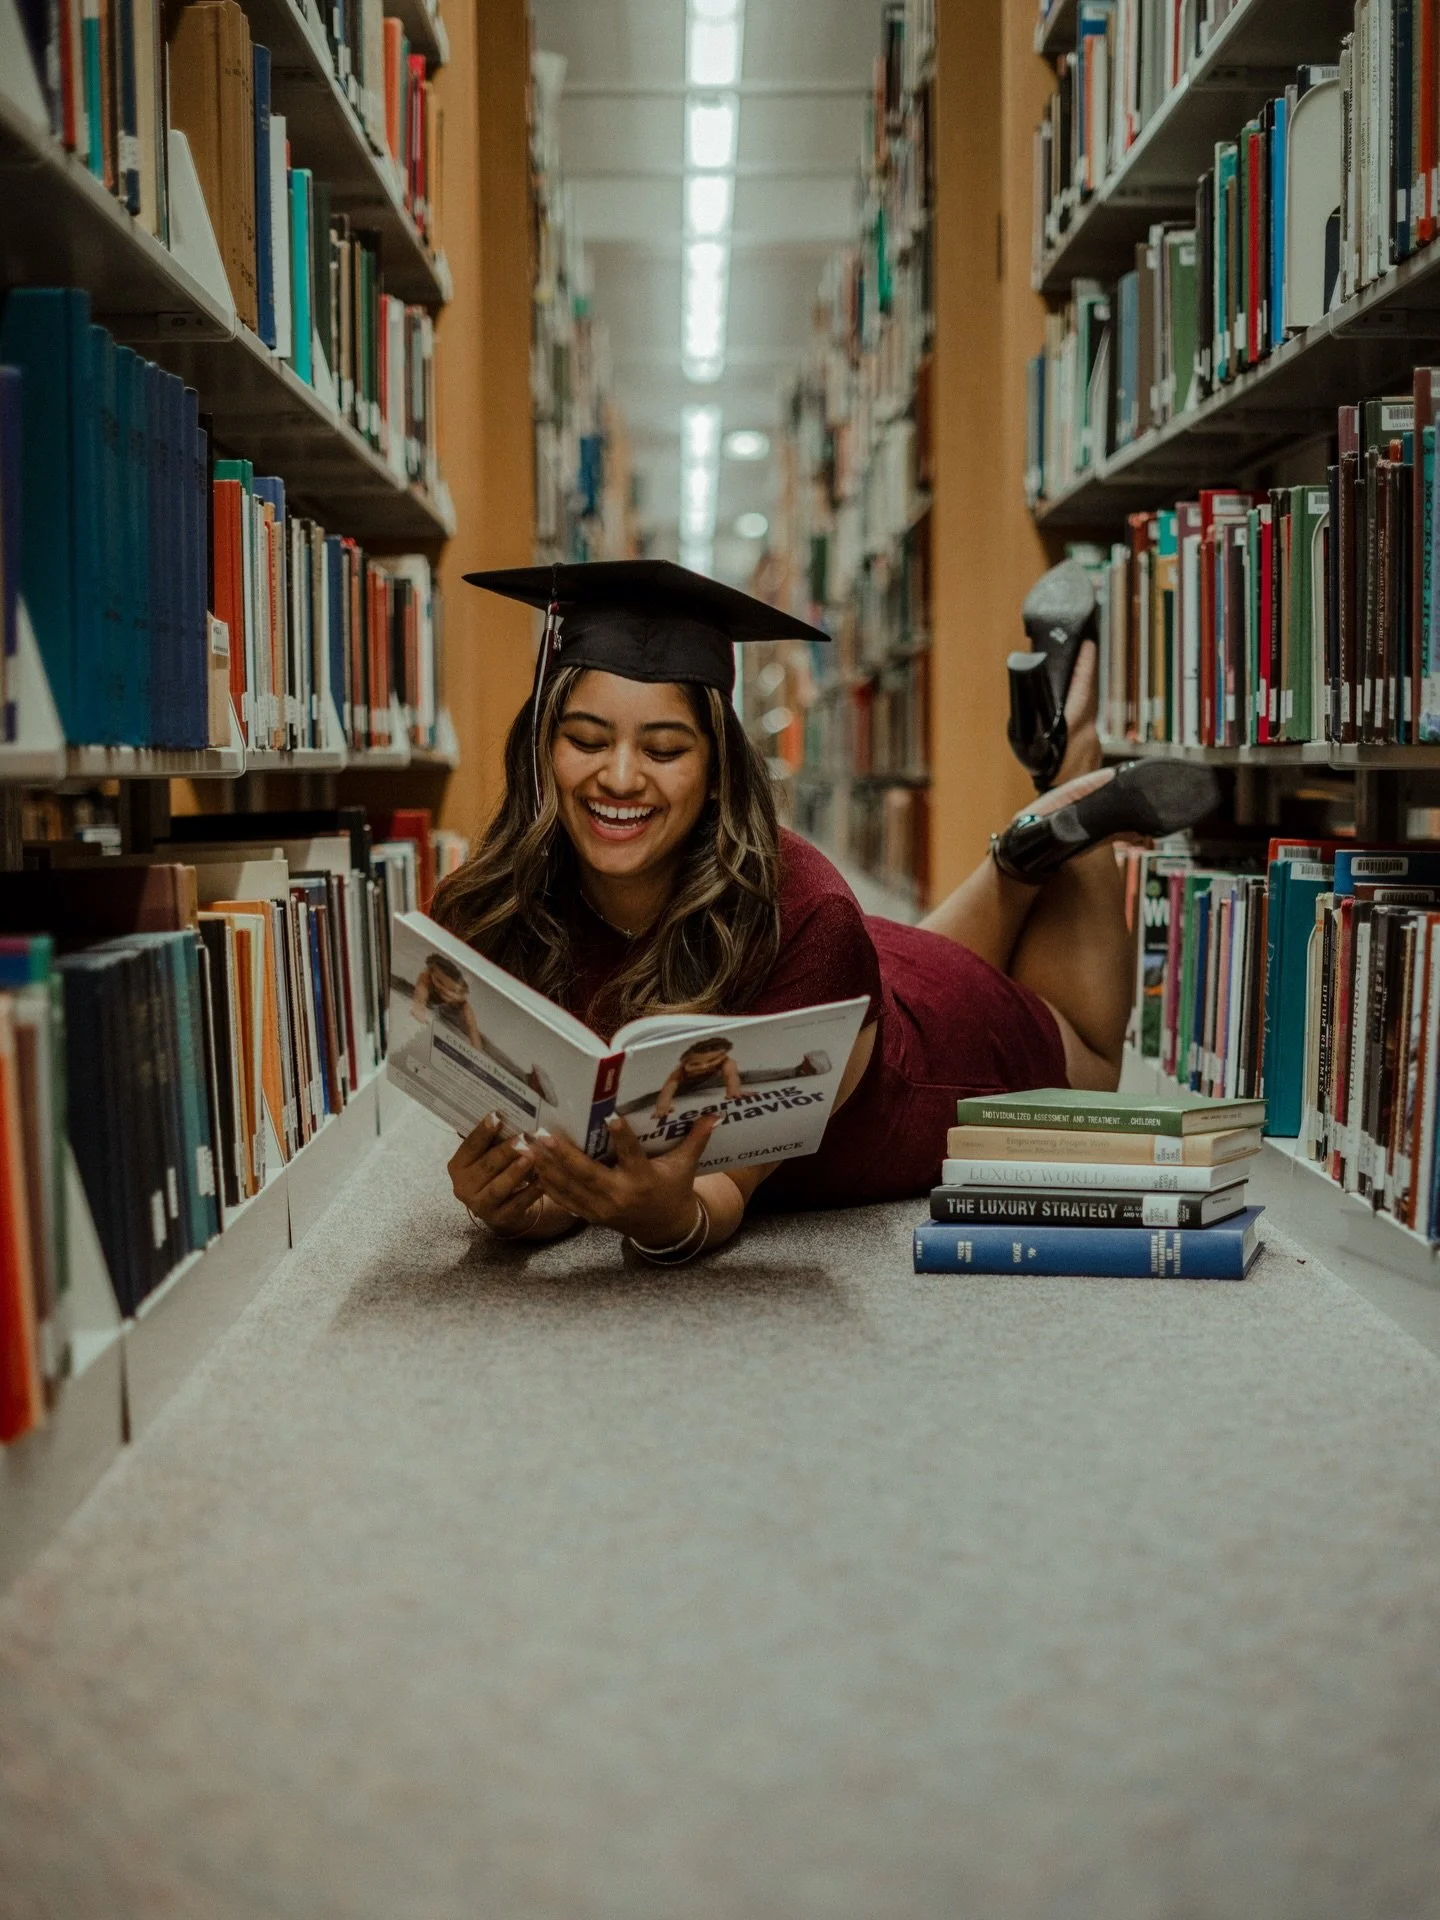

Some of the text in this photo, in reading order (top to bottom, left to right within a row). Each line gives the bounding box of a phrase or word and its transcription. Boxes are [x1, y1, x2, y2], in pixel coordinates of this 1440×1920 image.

[1421, 479, 1433, 680] MOCKING JUSTIC
[1318, 984, 1328, 1094] OPIUM REGIMES
[636, 1128, 665, 1144] nd
[664, 1090, 826, 1142] Bhavior
[656, 1085, 804, 1129] Learning
[982, 1110, 1031, 1121] INDIVIDUALIZED
[1033, 1112, 1070, 1123] ASSESSMENT
[1073, 1114, 1085, 1123] AND
[737, 1140, 805, 1162] CHANCE
[969, 1167, 1037, 1182] LUXURY
[1041, 1169, 1106, 1185] WORLD
[947, 1198, 975, 1214] THE
[979, 1200, 1037, 1216] LUXURY
[1041, 1201, 1119, 1219] STRATEGY
[1150, 1234, 1158, 1273] DISABILITIES
[1173, 1232, 1181, 1275] INTELLECTUAL
